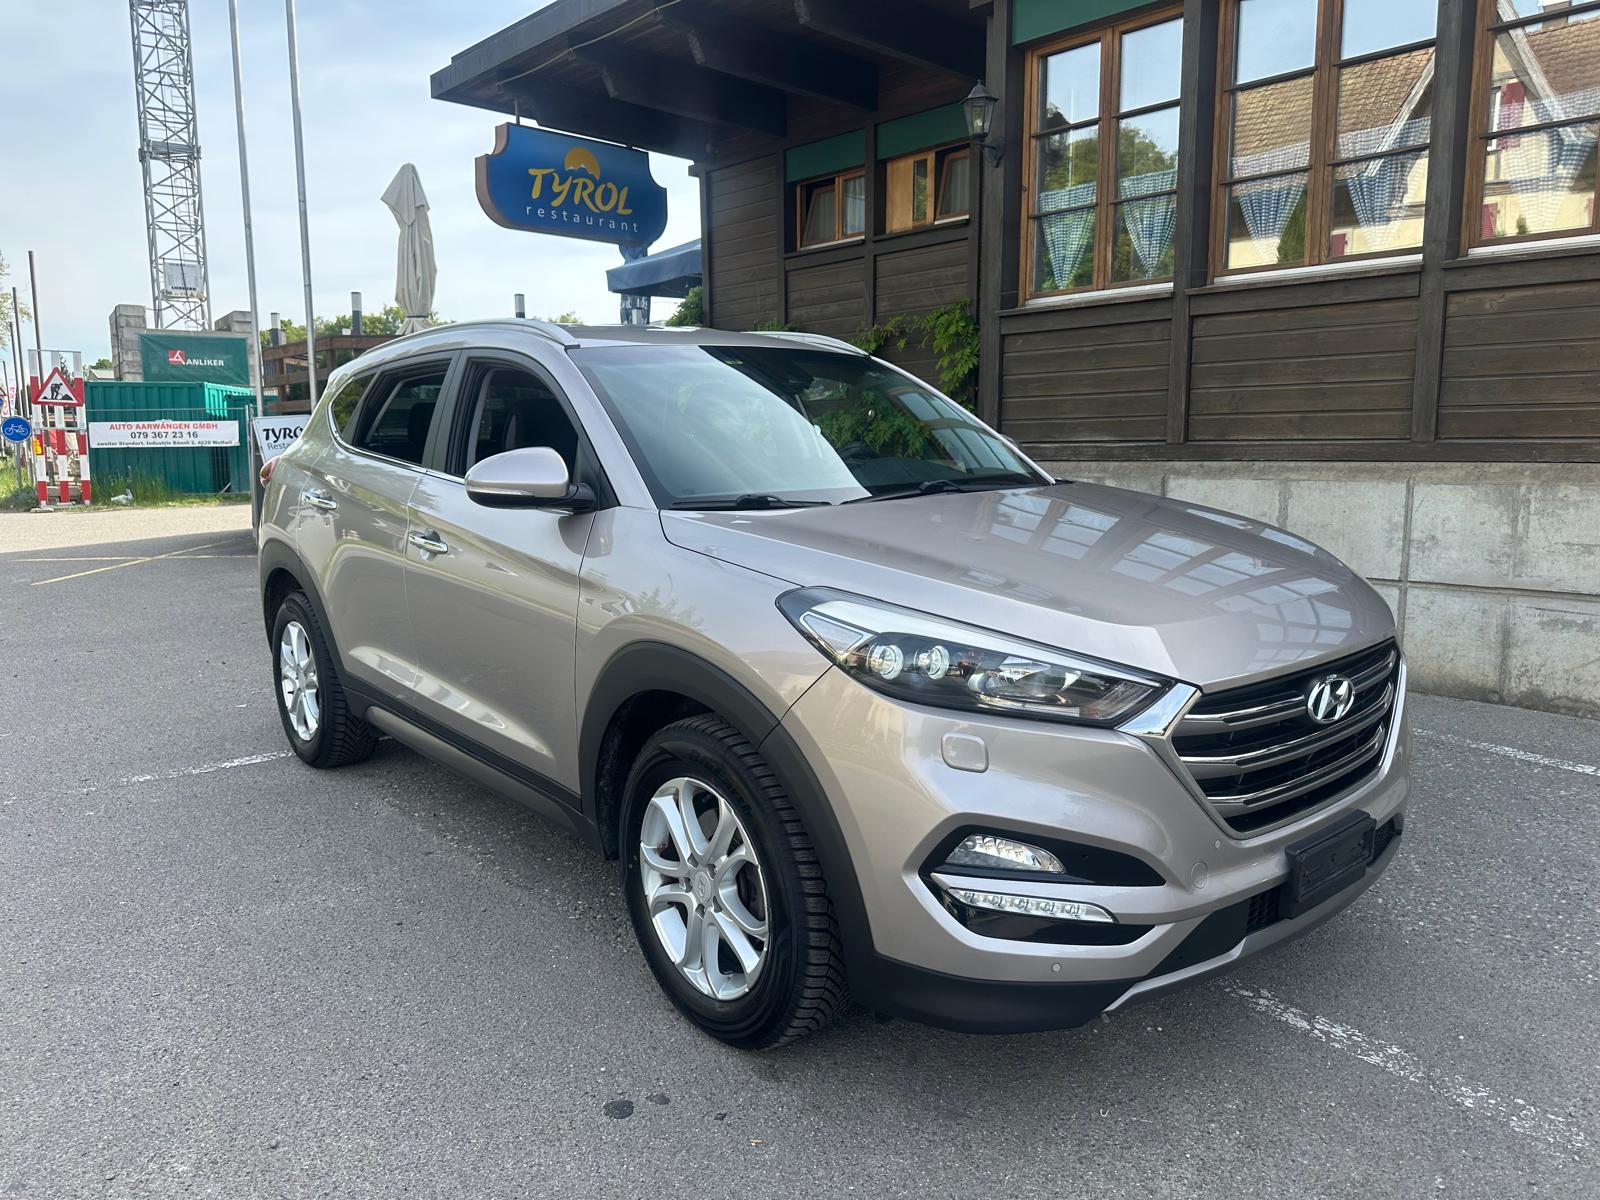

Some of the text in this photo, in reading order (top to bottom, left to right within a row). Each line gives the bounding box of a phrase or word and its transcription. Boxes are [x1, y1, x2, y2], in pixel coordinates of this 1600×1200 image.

[528, 168, 633, 215] TYROL
[525, 205, 638, 233] restaurant
[186, 358, 225, 367] ANLIKER
[109, 422, 218, 431] AUTO AARWANGEN GMBH
[130, 431, 149, 439] 079
[151, 431, 169, 439] 367
[172, 431, 184, 439] 23
